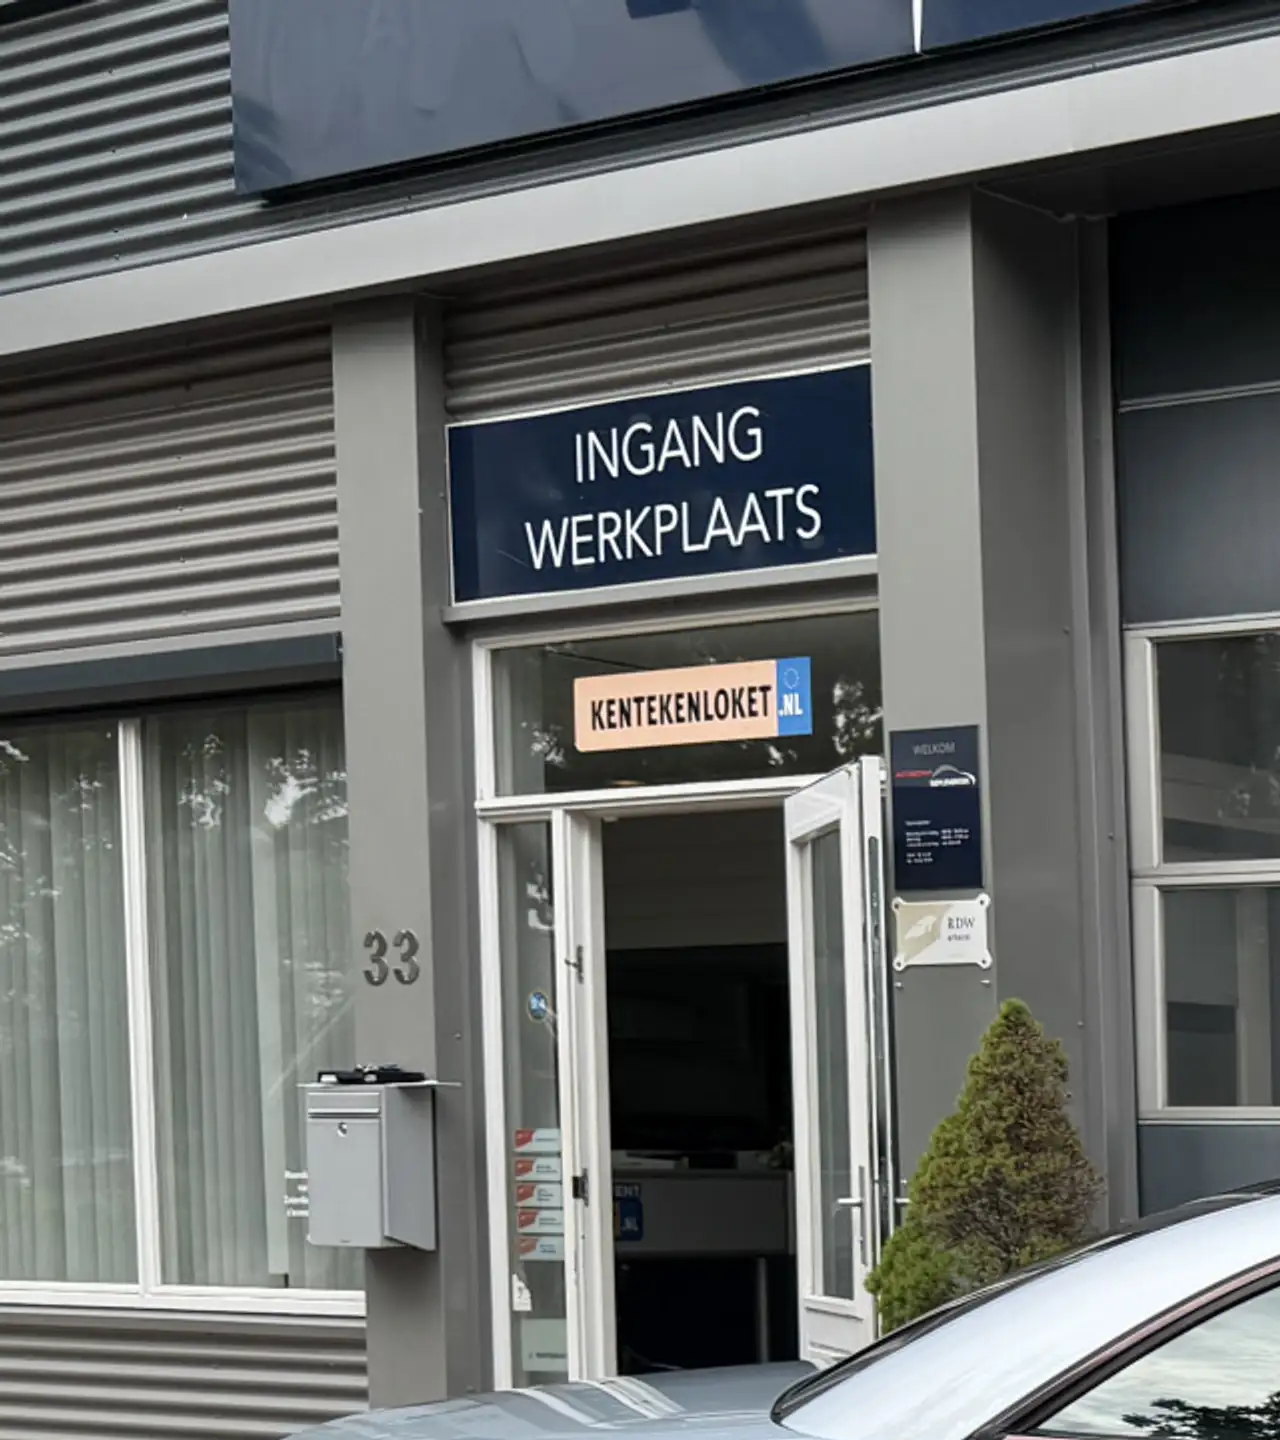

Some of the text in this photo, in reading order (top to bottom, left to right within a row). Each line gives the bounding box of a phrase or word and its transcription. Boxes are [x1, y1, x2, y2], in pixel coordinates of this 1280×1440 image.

[575, 406, 763, 483] INGANG
[525, 484, 822, 570] WERKPLAATS
[591, 685, 803, 731] KENTEKENLOKET .NL
[363, 928, 420, 986] 33
